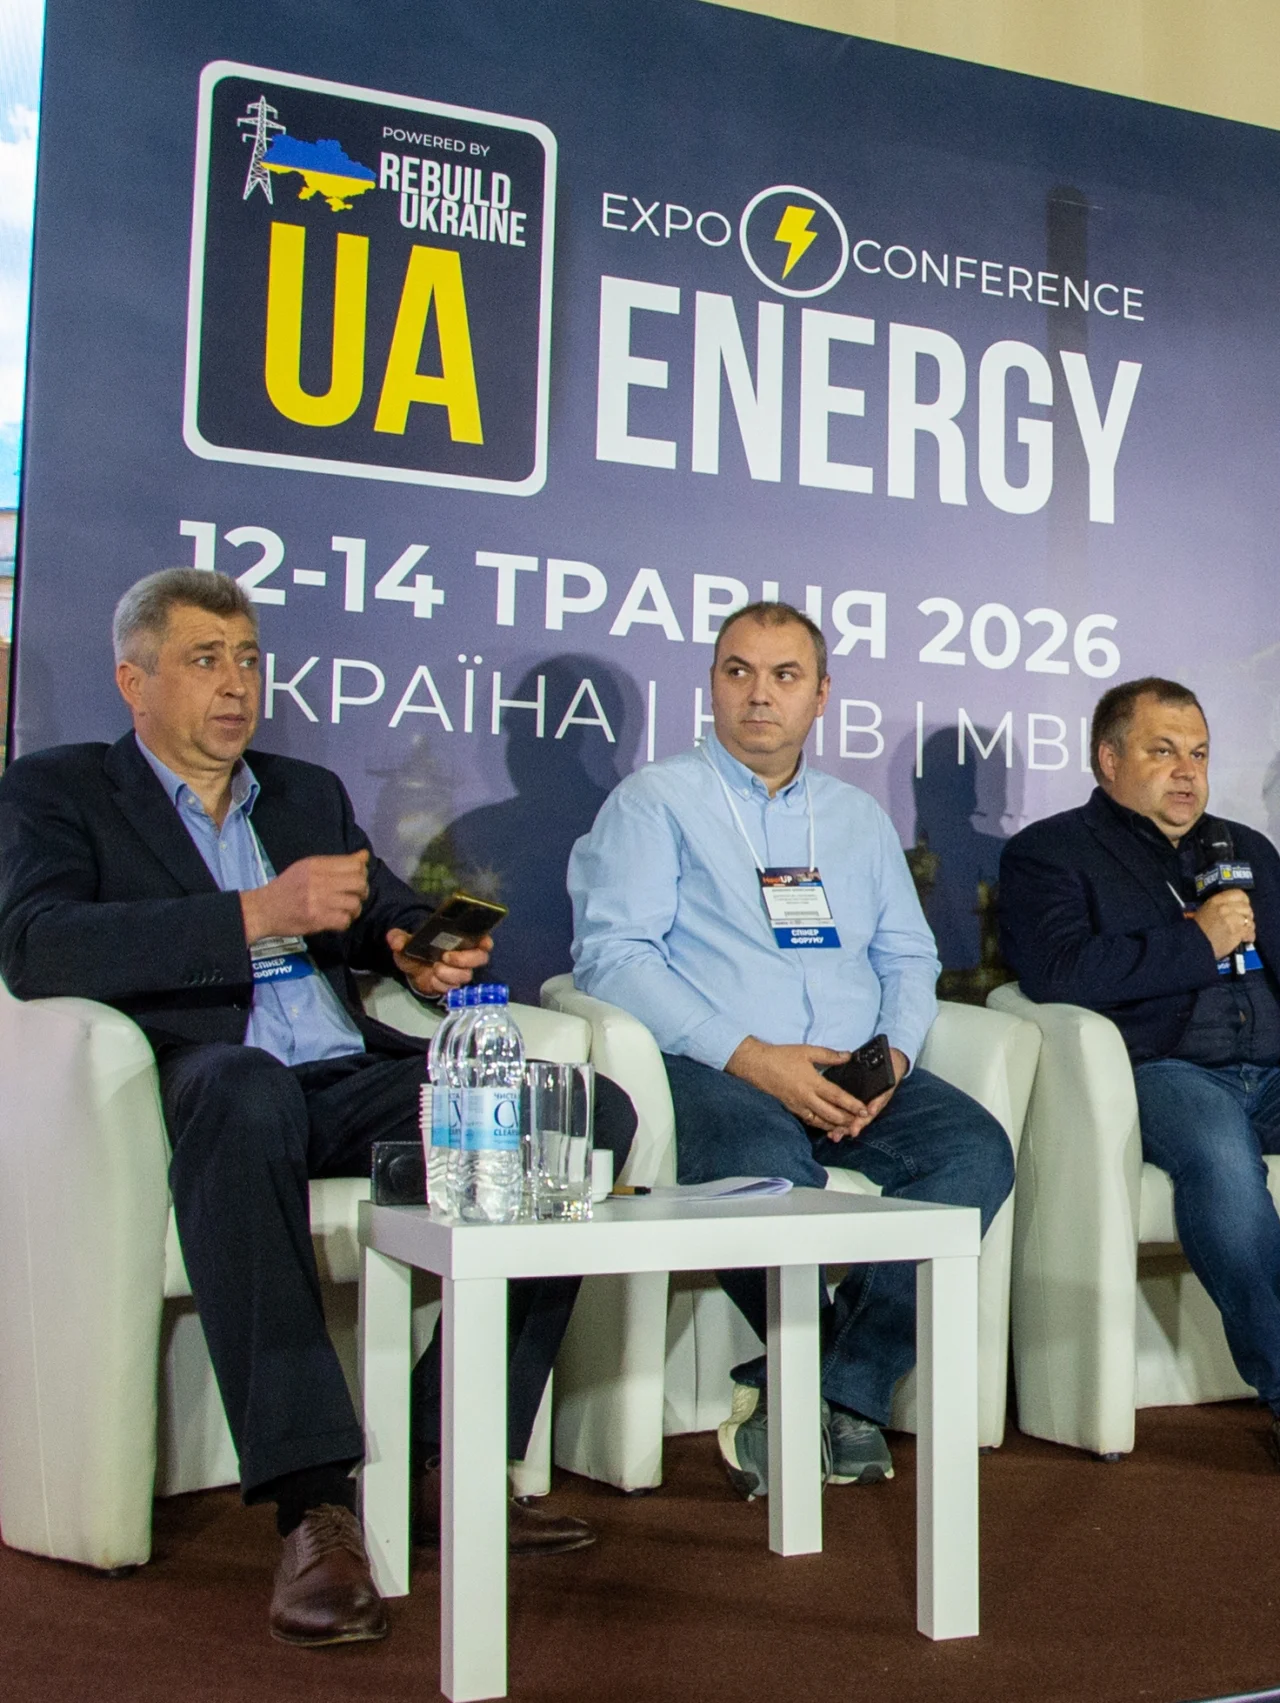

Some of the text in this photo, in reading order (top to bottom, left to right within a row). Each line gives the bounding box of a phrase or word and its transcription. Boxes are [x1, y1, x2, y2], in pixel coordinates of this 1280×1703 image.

[382, 126, 491, 157] POWERED BY
[379, 151, 511, 210] REBUILD
[400, 192, 527, 247] UKRAINE
[602, 192, 1145, 322] EXPO CONFERENCE
[264, 221, 484, 445] UA
[595, 275, 1143, 524] ENERGY
[179, 519, 445, 620] 12-14
[917, 596, 1122, 680] 2026
[264, 652, 616, 744] КРАЇНА
[252, 958, 285, 970] СПІКЕР
[253, 965, 292, 978] ФОРУМУ
